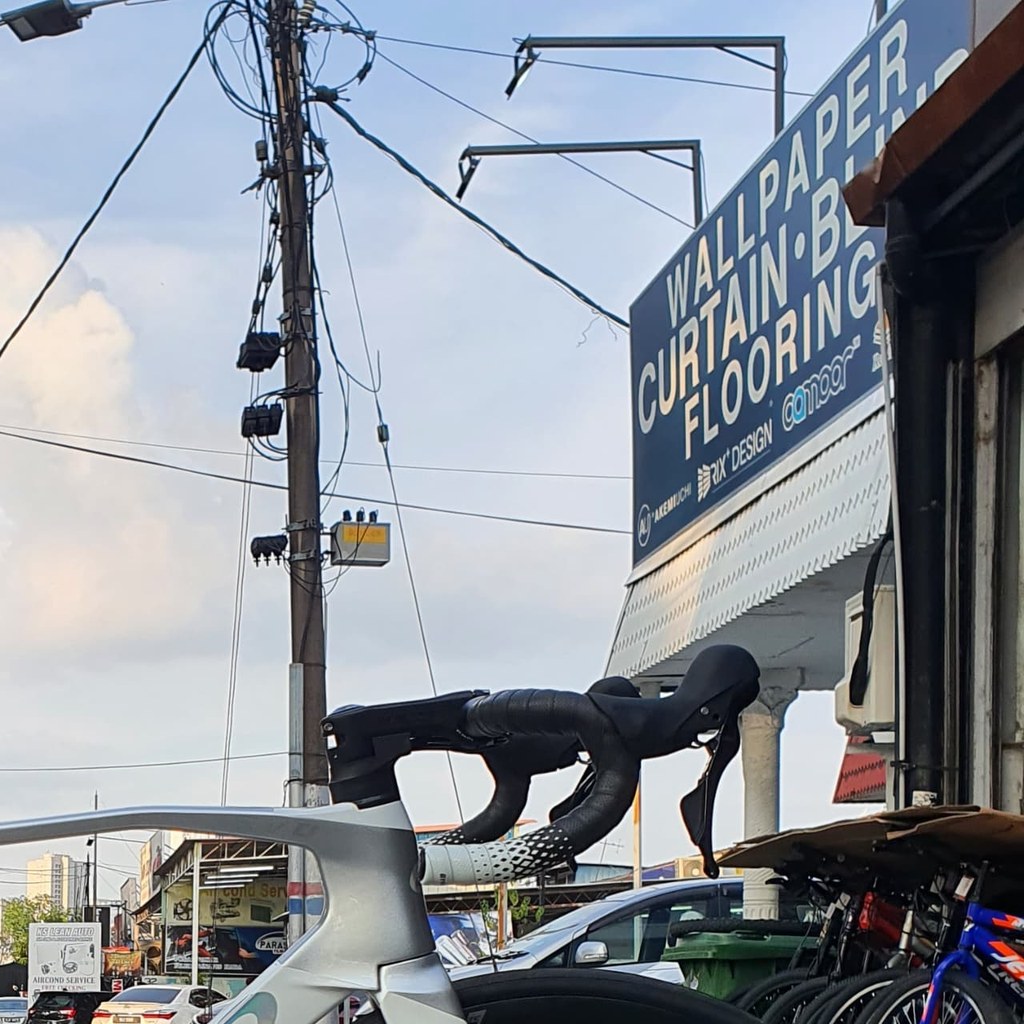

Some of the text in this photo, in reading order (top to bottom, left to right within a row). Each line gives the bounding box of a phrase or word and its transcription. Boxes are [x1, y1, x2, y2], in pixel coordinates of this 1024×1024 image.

[666, 19, 908, 328] WALLPAPER
[684, 240, 876, 460] FLOORING
[731, 418, 773, 472] DESIGN
